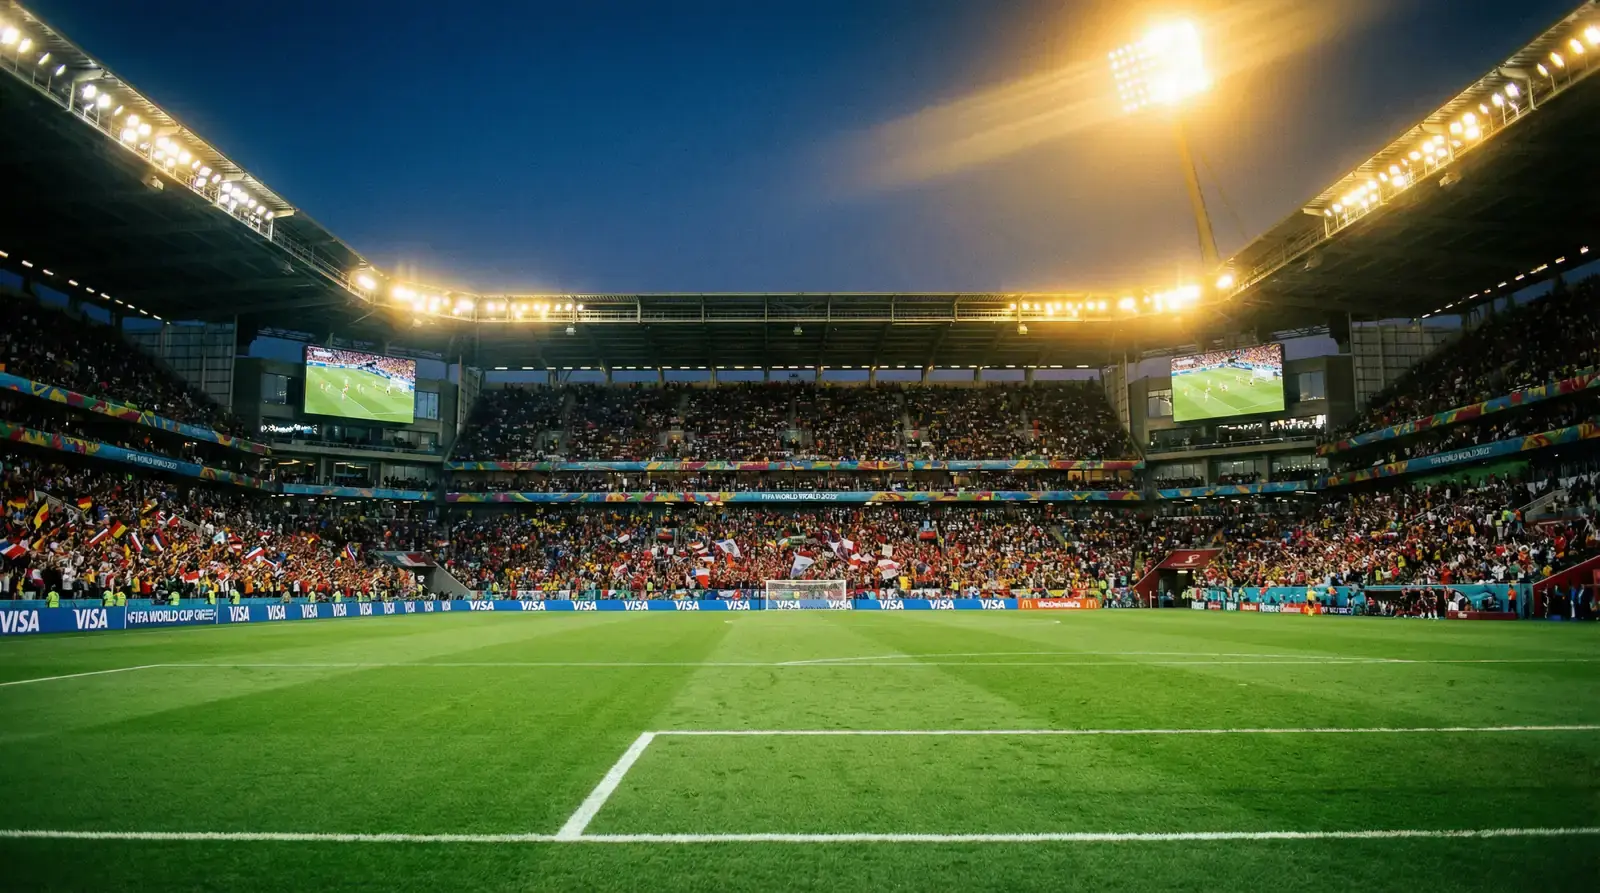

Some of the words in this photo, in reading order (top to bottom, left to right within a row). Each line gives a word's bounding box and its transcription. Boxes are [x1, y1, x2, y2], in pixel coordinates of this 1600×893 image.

[332, 604, 347, 617] VISA
[359, 603, 373, 616] VISA
[469, 600, 495, 611] VISA
[520, 600, 546, 611] VISA
[572, 600, 597, 611] VISA
[622, 600, 649, 611] VISA
[674, 600, 700, 611] VISA
[724, 600, 750, 611] VISA
[776, 600, 800, 610] VISA
[827, 600, 853, 610] VISA
[879, 600, 905, 610] VISA
[930, 600, 955, 610] VISA
[981, 600, 1006, 610] VISA
[129, 611, 149, 624] FIFA
[149, 610, 178, 622] WORLD
[179, 609, 194, 621] CUP
[228, 606, 250, 622] VISA
[267, 605, 286, 620] VISA
[301, 604, 318, 618] VISA
[0, 611, 40, 633] VISA
[73, 609, 109, 629] VISA
